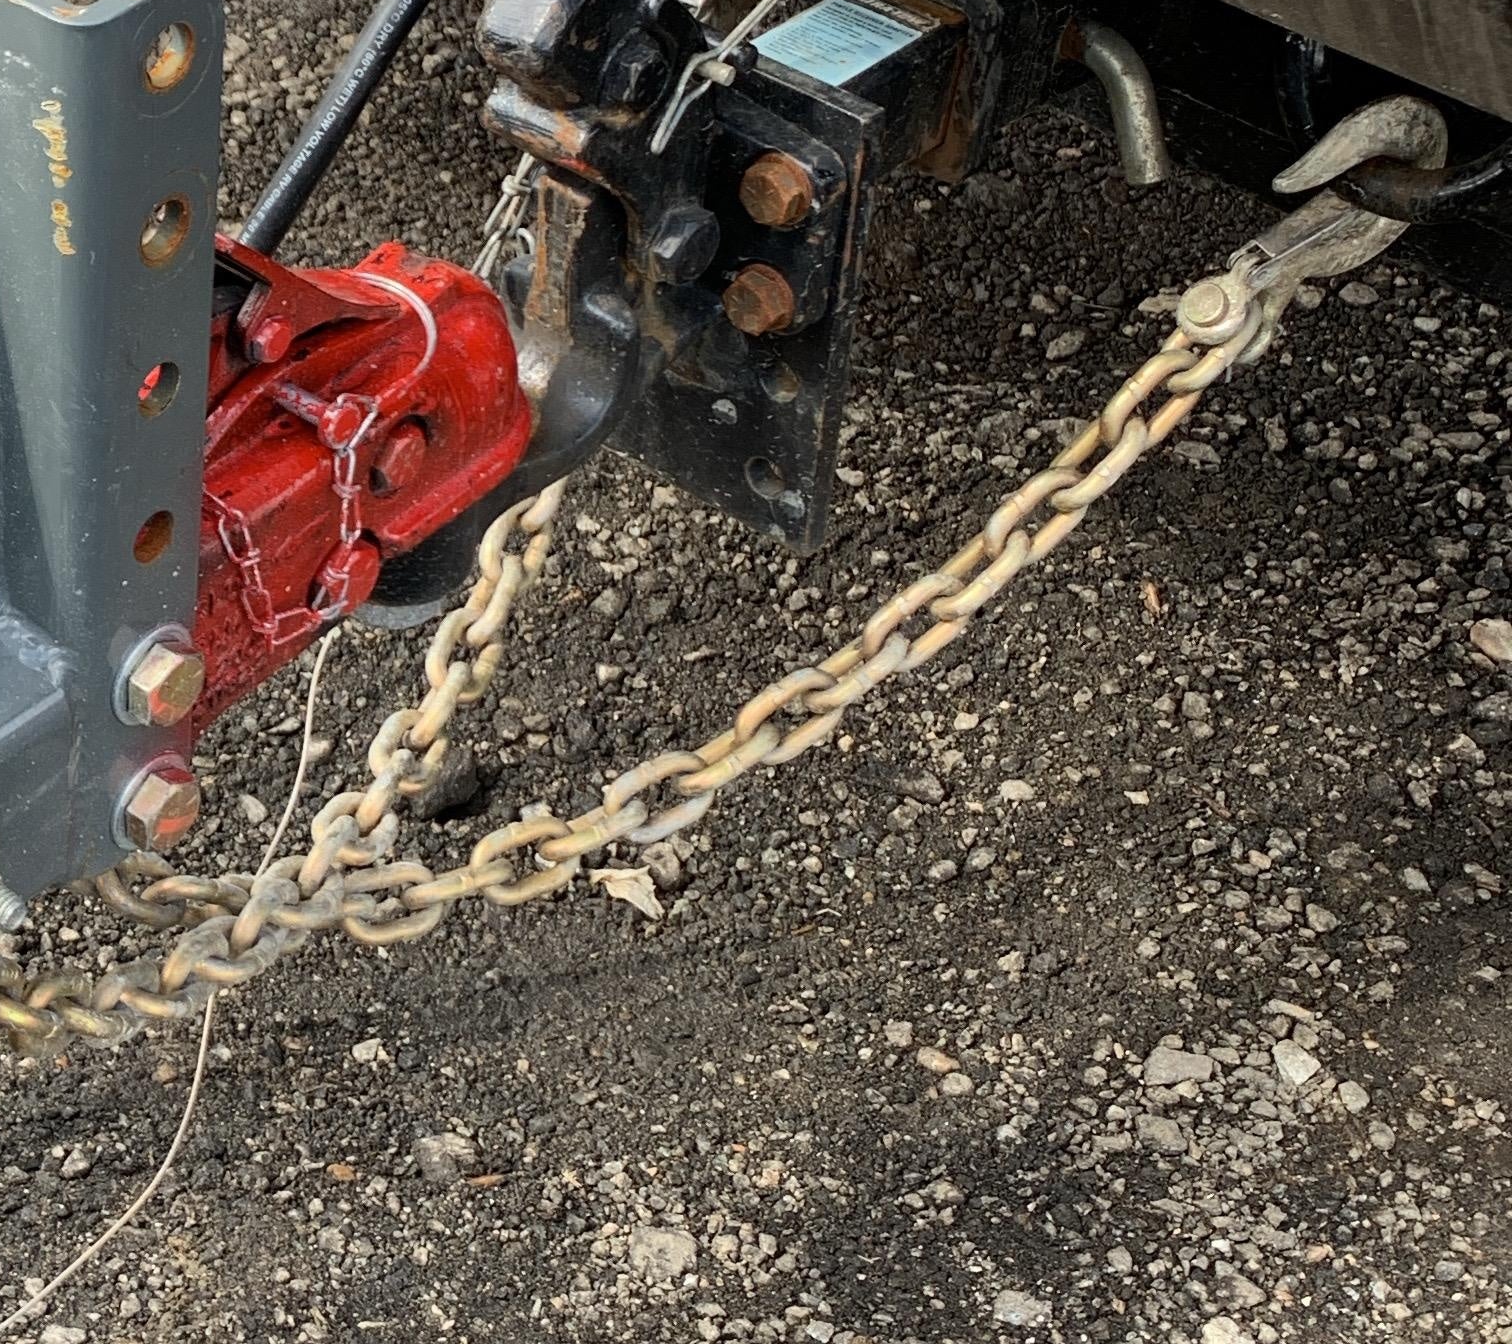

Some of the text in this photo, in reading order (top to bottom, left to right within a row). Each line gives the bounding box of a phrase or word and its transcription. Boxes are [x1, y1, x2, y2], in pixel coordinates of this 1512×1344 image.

[374, 22, 395, 50] DRY
[336, 78, 361, 108] WET)
[319, 106, 342, 133] LOW
[287, 130, 325, 177] VOLTAGE
